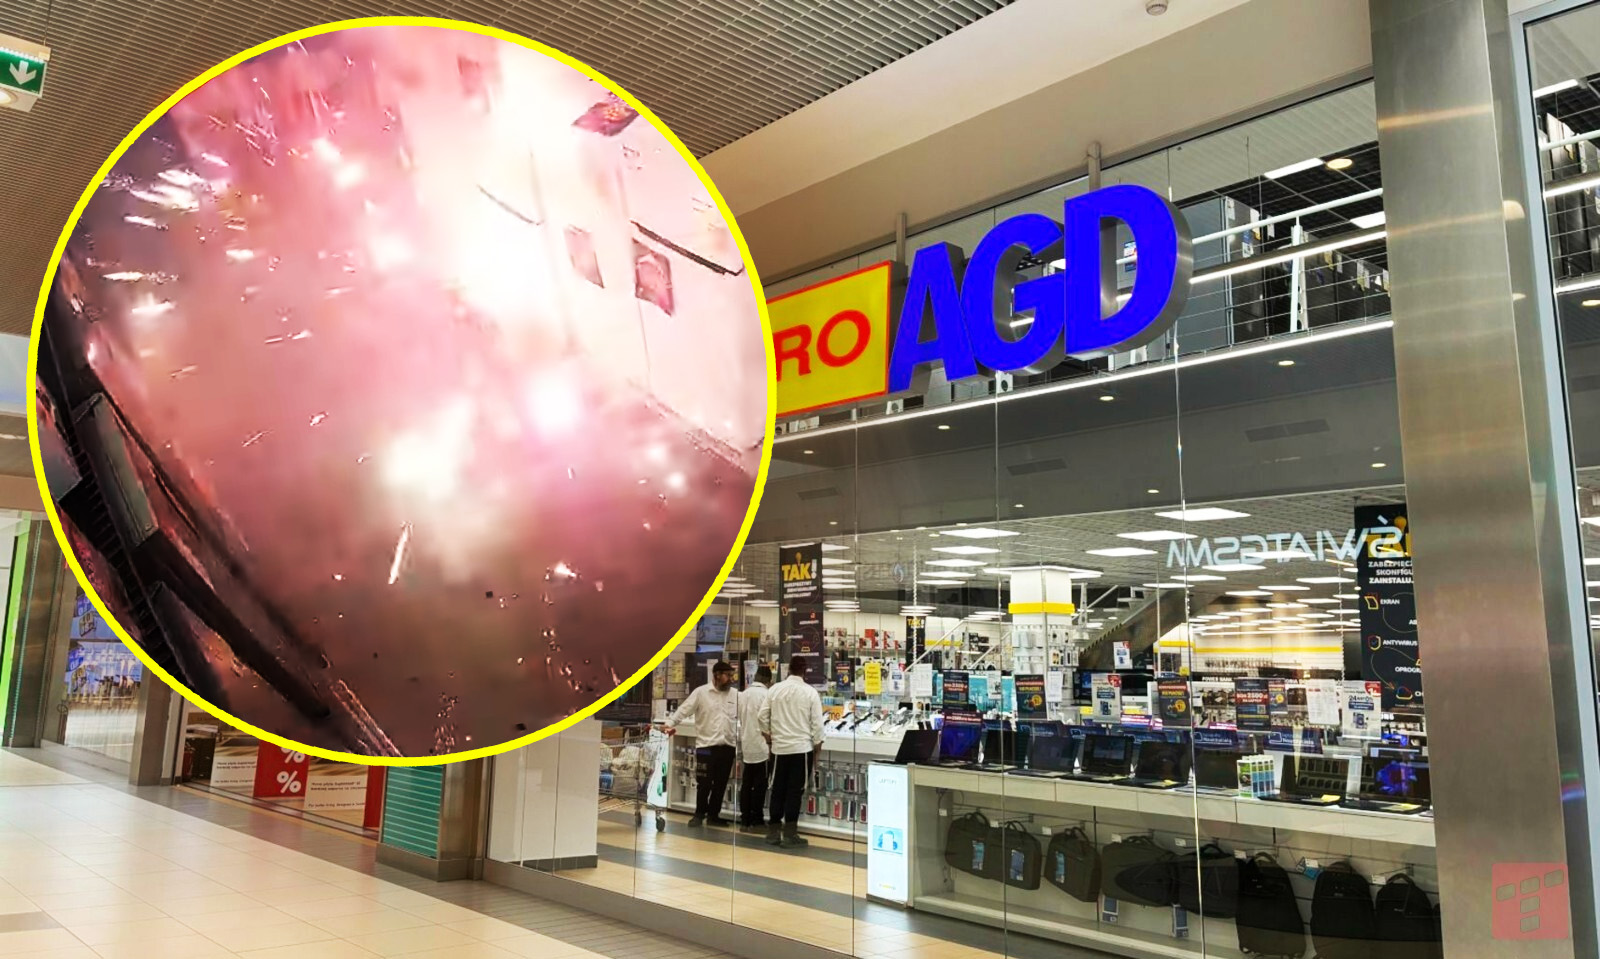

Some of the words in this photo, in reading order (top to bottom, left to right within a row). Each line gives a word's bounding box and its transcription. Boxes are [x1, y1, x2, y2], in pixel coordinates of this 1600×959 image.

[773, 309, 871, 382] RO
[888, 184, 1178, 395] AGD
[782, 559, 817, 581] TAK!
[276, 771, 302, 794] %
